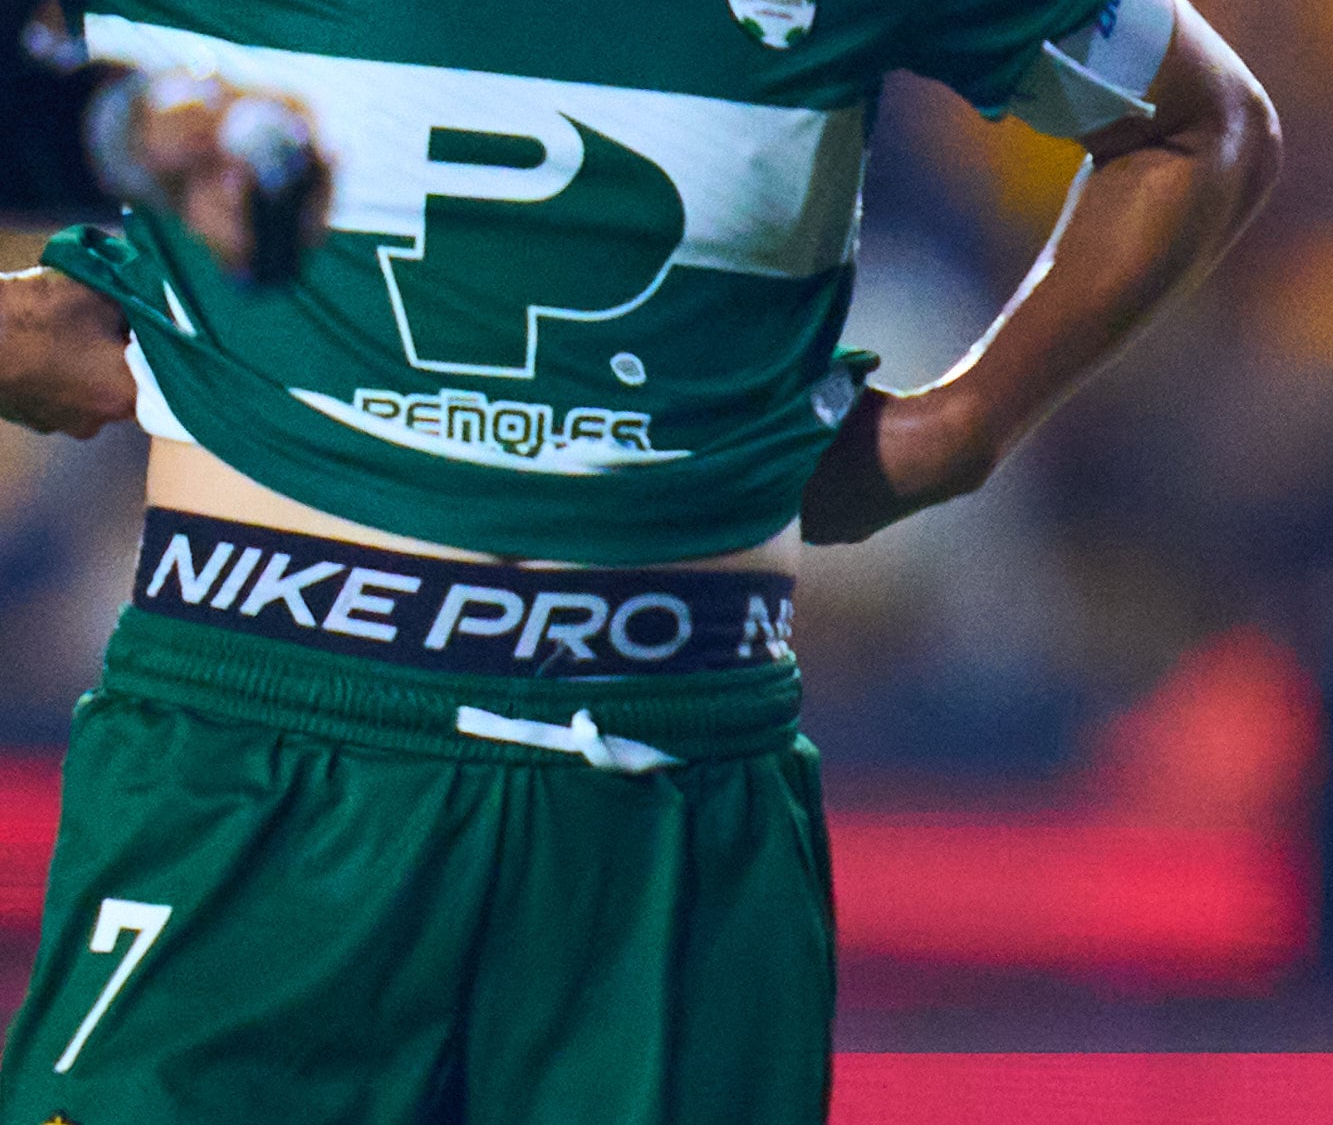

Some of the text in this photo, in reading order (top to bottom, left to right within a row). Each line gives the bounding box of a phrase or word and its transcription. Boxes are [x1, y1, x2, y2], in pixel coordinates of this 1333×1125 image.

[146, 533, 422, 642] NIKE
[423, 583, 693, 661] PRO
[54, 898, 173, 1073] 7
